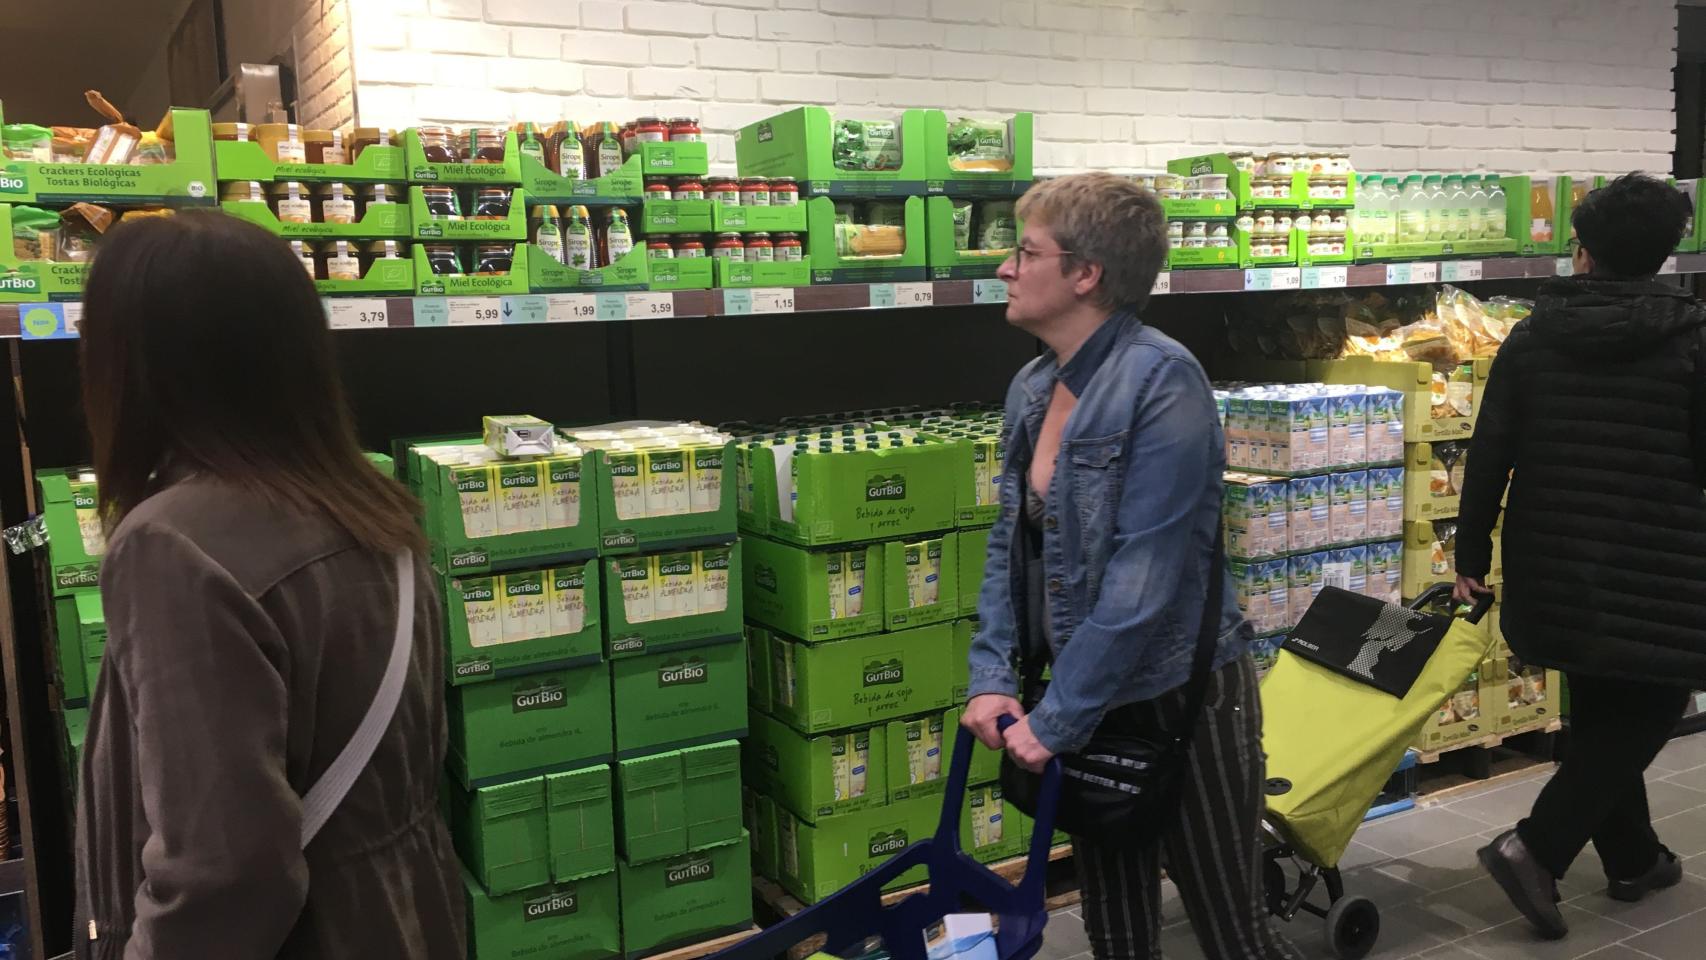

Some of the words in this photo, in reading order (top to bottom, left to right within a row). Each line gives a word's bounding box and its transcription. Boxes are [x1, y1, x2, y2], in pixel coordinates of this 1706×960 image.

[39, 166, 84, 176] Crackers
[88, 168, 141, 179] Ecológicas
[443, 165, 463, 174] Miel
[466, 166, 505, 176] Ecológica
[46, 177, 79, 186] Tostas
[83, 178, 136, 189] Biológicas
[447, 222, 467, 231] Miel
[470, 222, 510, 233] Ecológica
[450, 278, 469, 286] Miel
[472, 278, 512, 288] Ecológica
[915, 292, 932, 302] 0,79
[651, 303, 671, 314] 3,59
[774, 298, 793, 309] 1,15
[360, 312, 385, 322] 3,79
[475, 309, 498, 320] 5,99
[574, 306, 595, 317] 1,99
[652, 462, 680, 471] GUTBIO
[503, 475, 535, 486] GUTBIO
[869, 486, 903, 497] GUTBIO
[857, 507, 883, 519] Bebida
[886, 507, 897, 515] de
[900, 506, 915, 519] soja
[605, 537, 634, 546] GUTBIO
[453, 556, 485, 566] GUTBIO
[661, 564, 690, 575] GUTBIO
[61, 575, 98, 585] GUTBIO
[508, 582, 540, 594] GUTBIO
[613, 640, 642, 651] GUTBIO
[457, 663, 490, 675] GUTBIO
[662, 668, 703, 683] GUTBIO
[866, 670, 900, 683] GUTBIO
[517, 691, 562, 707] GUTBIO
[854, 688, 881, 705] Bebida
[885, 689, 895, 698] de
[898, 687, 913, 701] soja
[908, 730, 919, 739] BIO
[872, 839, 904, 853] GUTBIO
[669, 866, 710, 882] GUTBIO
[528, 897, 573, 915] GUTBIO
